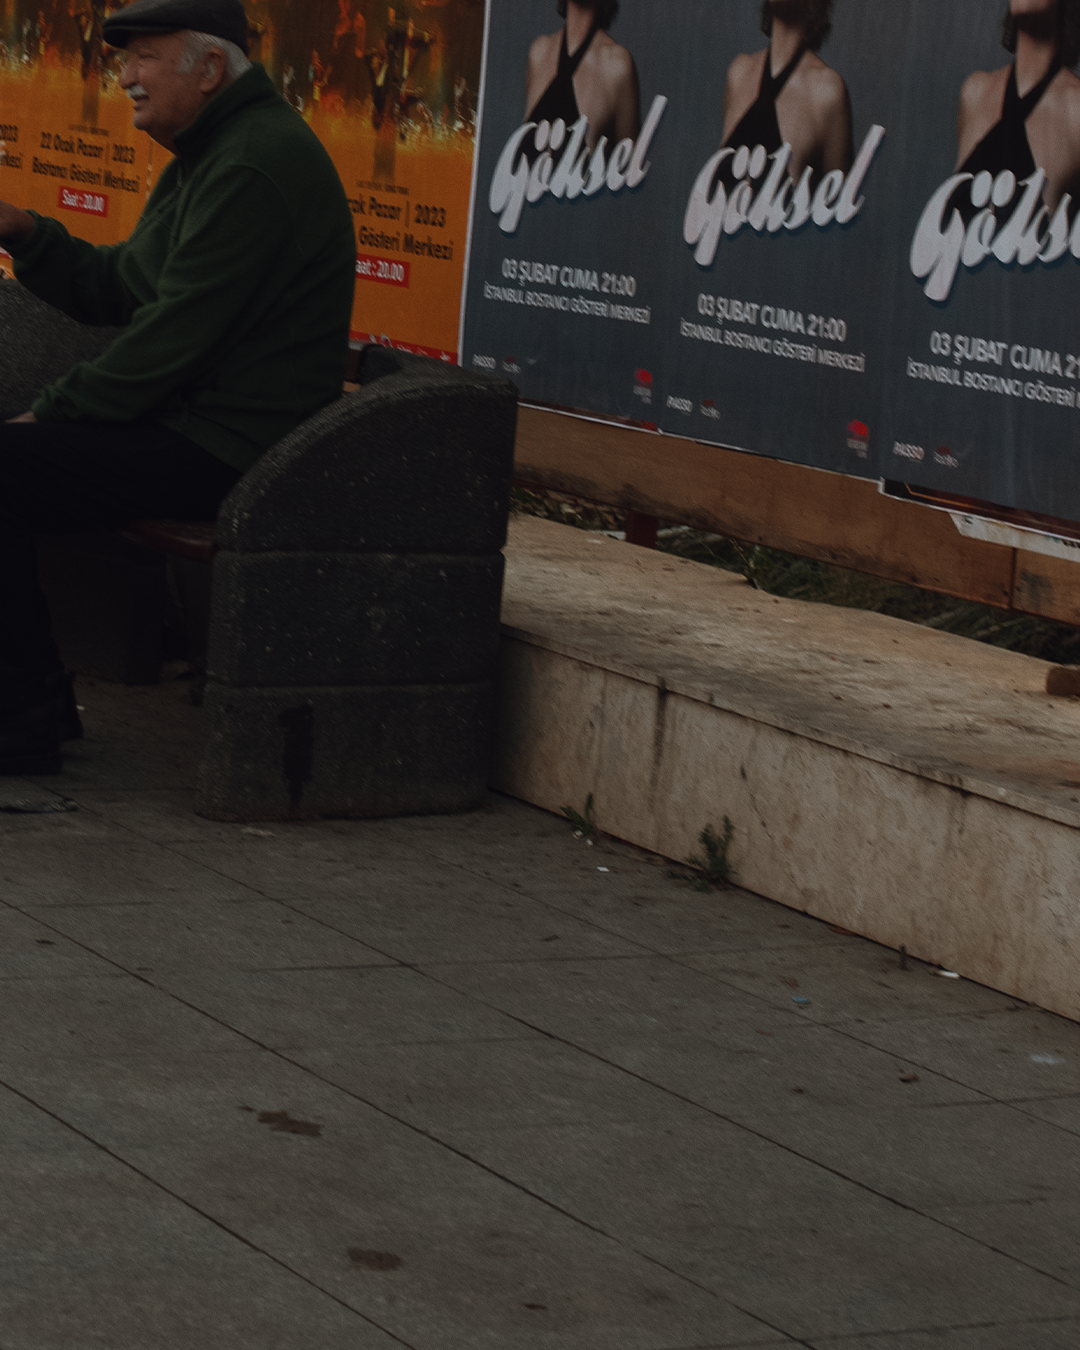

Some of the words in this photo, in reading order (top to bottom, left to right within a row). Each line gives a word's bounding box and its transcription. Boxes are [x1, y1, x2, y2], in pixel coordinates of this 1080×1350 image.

[489, 94, 668, 233] Göksel
[368, 196, 401, 221] Pazar
[414, 203, 447, 228] 2023
[683, 123, 886, 267] Göksel
[359, 225, 401, 251] Gösteri
[402, 232, 454, 261] Merkezi
[355, 258, 405, 282] aat:20.00
[502, 258, 518, 280] 03
[518, 260, 561, 287] ŞUBAT
[560, 266, 600, 293] CUMA
[601, 271, 637, 298] 21:00
[483, 281, 526, 305] İSTANBUL
[526, 291, 570, 313] BOSTANCI
[680, 317, 723, 344] İSTANBUL
[724, 331, 772, 354] BOSTANCI
[697, 293, 715, 316] 03
[715, 295, 761, 325] ŞUBAT
[760, 304, 806, 335] CUMA
[807, 313, 847, 343] 21:00
[930, 331, 952, 357] 03
[953, 334, 1009, 366] ŞUBAT
[1009, 343, 1063, 378] CUMA
[907, 356, 962, 387] İSTANBUL
[963, 370, 1023, 398] BOSTANCI
[1024, 379, 1076, 408] GÖSTERİ
